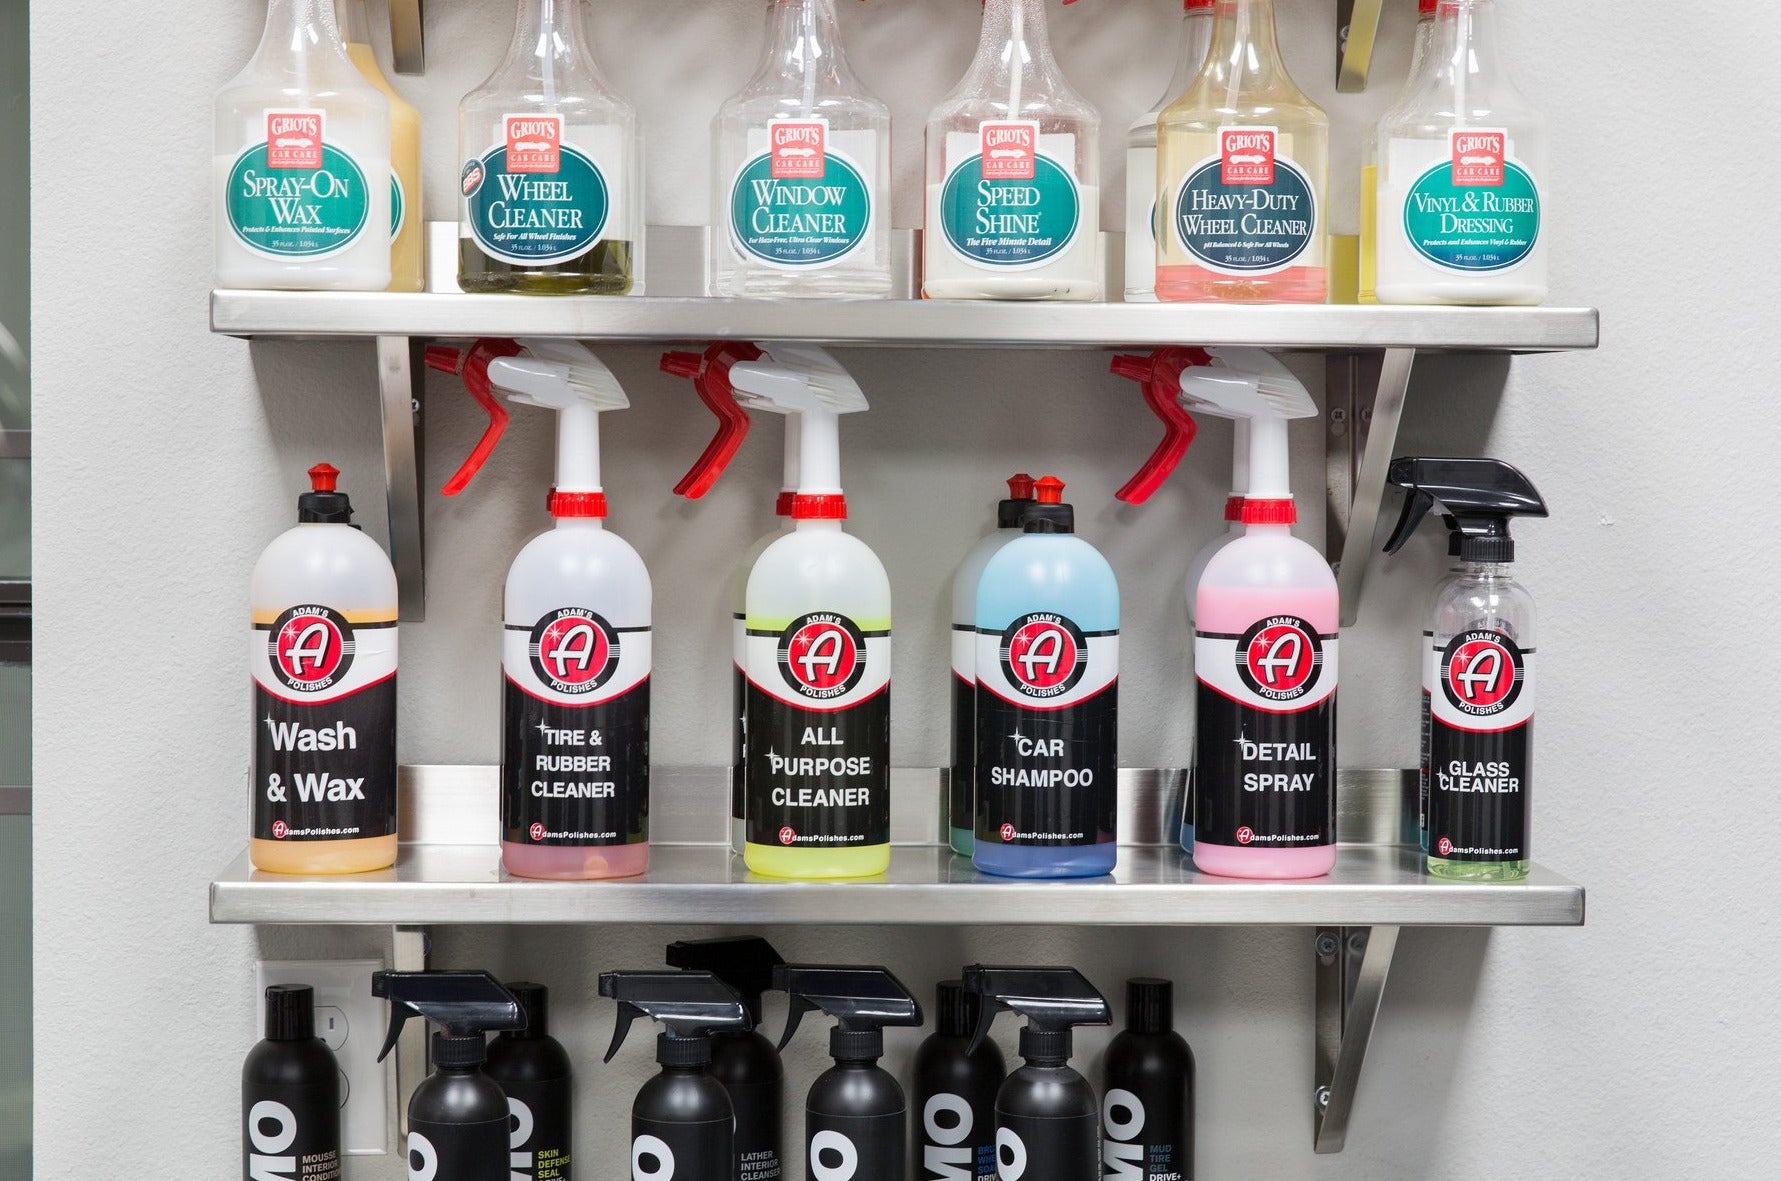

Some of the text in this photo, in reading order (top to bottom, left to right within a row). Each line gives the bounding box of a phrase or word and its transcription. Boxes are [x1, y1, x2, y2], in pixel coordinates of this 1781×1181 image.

[271, 117, 318, 136] GRIOT'S
[511, 121, 556, 140] GRIOT'S
[775, 126, 820, 145] GRIOT'S
[986, 128, 1030, 146] GRIOT'S
[1226, 134, 1270, 152] GRIOT'S
[1456, 136, 1500, 154] GRIOT'S
[243, 169, 349, 198] SPRAY-ON
[496, 174, 573, 201] WHEEL
[751, 179, 847, 206] WINDOW
[977, 179, 1041, 207] SPEED
[1191, 189, 1299, 211] HEAVY-DUTY
[1414, 191, 1534, 213] VINYL & RUBBER
[268, 197, 323, 225] WAX
[488, 200, 584, 229] CLEANER
[752, 206, 847, 234] CLEANER
[1182, 213, 1308, 236] WHEEL CLEANER
[1440, 213, 1514, 234] DRESSING
[493, 233, 506, 241] Safe
[967, 237, 1052, 246] The Five Minute Detail
[292, 607, 328, 618] ADAM'S
[557, 609, 593, 619] ADAM'S
[806, 614, 841, 625] ADAM'S
[1027, 614, 1061, 624] ADAM'S
[1266, 618, 1300, 628] ADAM'S
[1465, 633, 1501, 642] ADAM'S
[285, 623, 330, 675] A
[549, 624, 596, 677] A
[797, 629, 843, 682] A
[1018, 629, 1063, 681] A
[1257, 632, 1301, 684] A
[1458, 648, 1504, 699] A
[287, 676, 332, 691] POLISHES
[550, 679, 598, 693] POLISHES
[800, 684, 846, 698] POLISHES
[1020, 683, 1066, 697] POLISHES
[1259, 686, 1304, 700] POLISHES
[1458, 702, 1504, 715] POLISHES
[270, 720, 356, 752] Wash
[544, 729, 602, 746] TIRE &
[801, 727, 844, 745] ALL
[1018, 738, 1064, 757] CAR
[1242, 743, 1316, 761] DETAIL
[536, 755, 610, 772] RUBBER
[771, 756, 871, 776] PURPOSE
[1449, 760, 1510, 778] GLASS
[991, 766, 1093, 788] SHAMPOO
[1243, 773, 1315, 792] SPRAY
[1439, 777, 1519, 793] CLEANER
[267, 772, 365, 803] & Wax
[531, 781, 615, 798] CLEANER
[772, 788, 870, 807] CLEANER
[302, 1150, 336, 1164] MOUSSE
[538, 1149, 559, 1159] SKIN
[741, 1150, 773, 1161] LATHER
[1150, 1145, 1172, 1153] MUD
[302, 1160, 338, 1174] INTERIOR
[538, 1168, 560, 1179] SEAL
[741, 1158, 778, 1171] INTERIOR
[741, 1168, 781, 1181] CLEANSER
